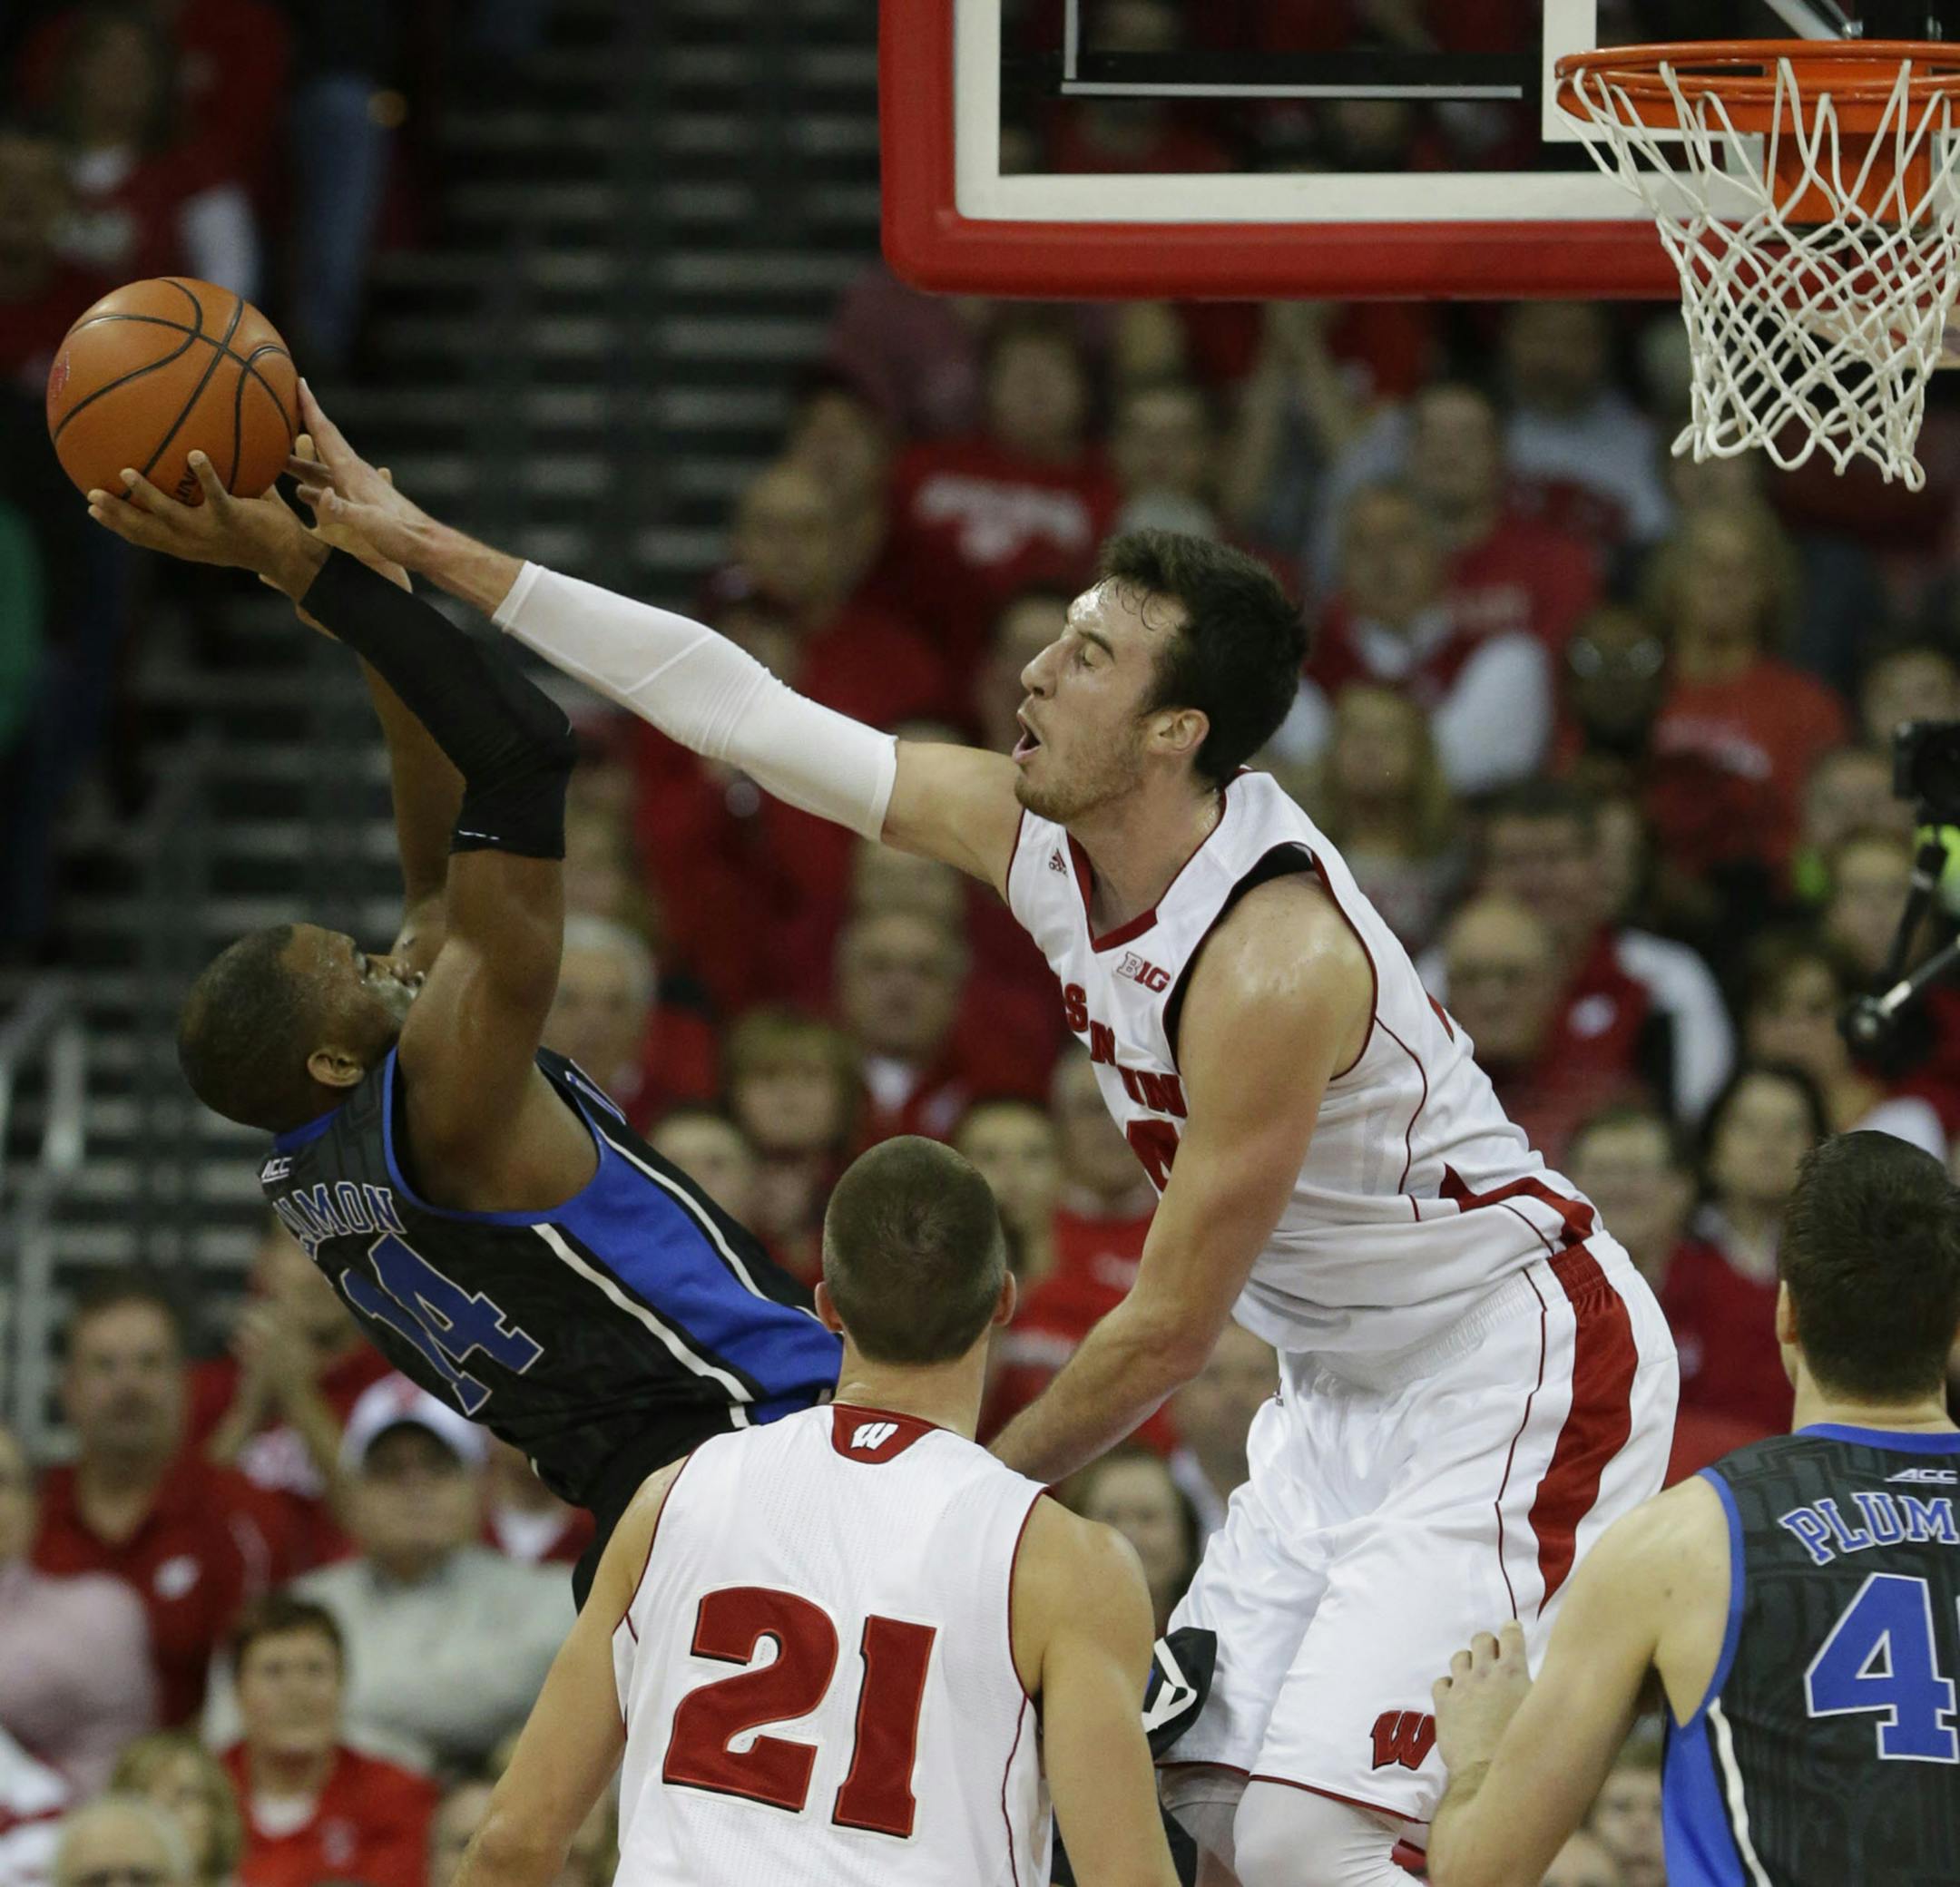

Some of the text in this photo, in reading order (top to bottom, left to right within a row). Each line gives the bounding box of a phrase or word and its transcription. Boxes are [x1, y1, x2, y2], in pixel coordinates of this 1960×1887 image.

[261, 1157, 293, 1184] ACC
[339, 1231, 544, 1417] 14
[849, 1421, 900, 1452] W
[1884, 1468, 1958, 1484] ACC
[1778, 1491, 1960, 1566] PLUM
[1803, 1571, 1960, 1765] 4
[662, 1582, 938, 1840] 21
[1369, 1709, 1436, 1771] W
